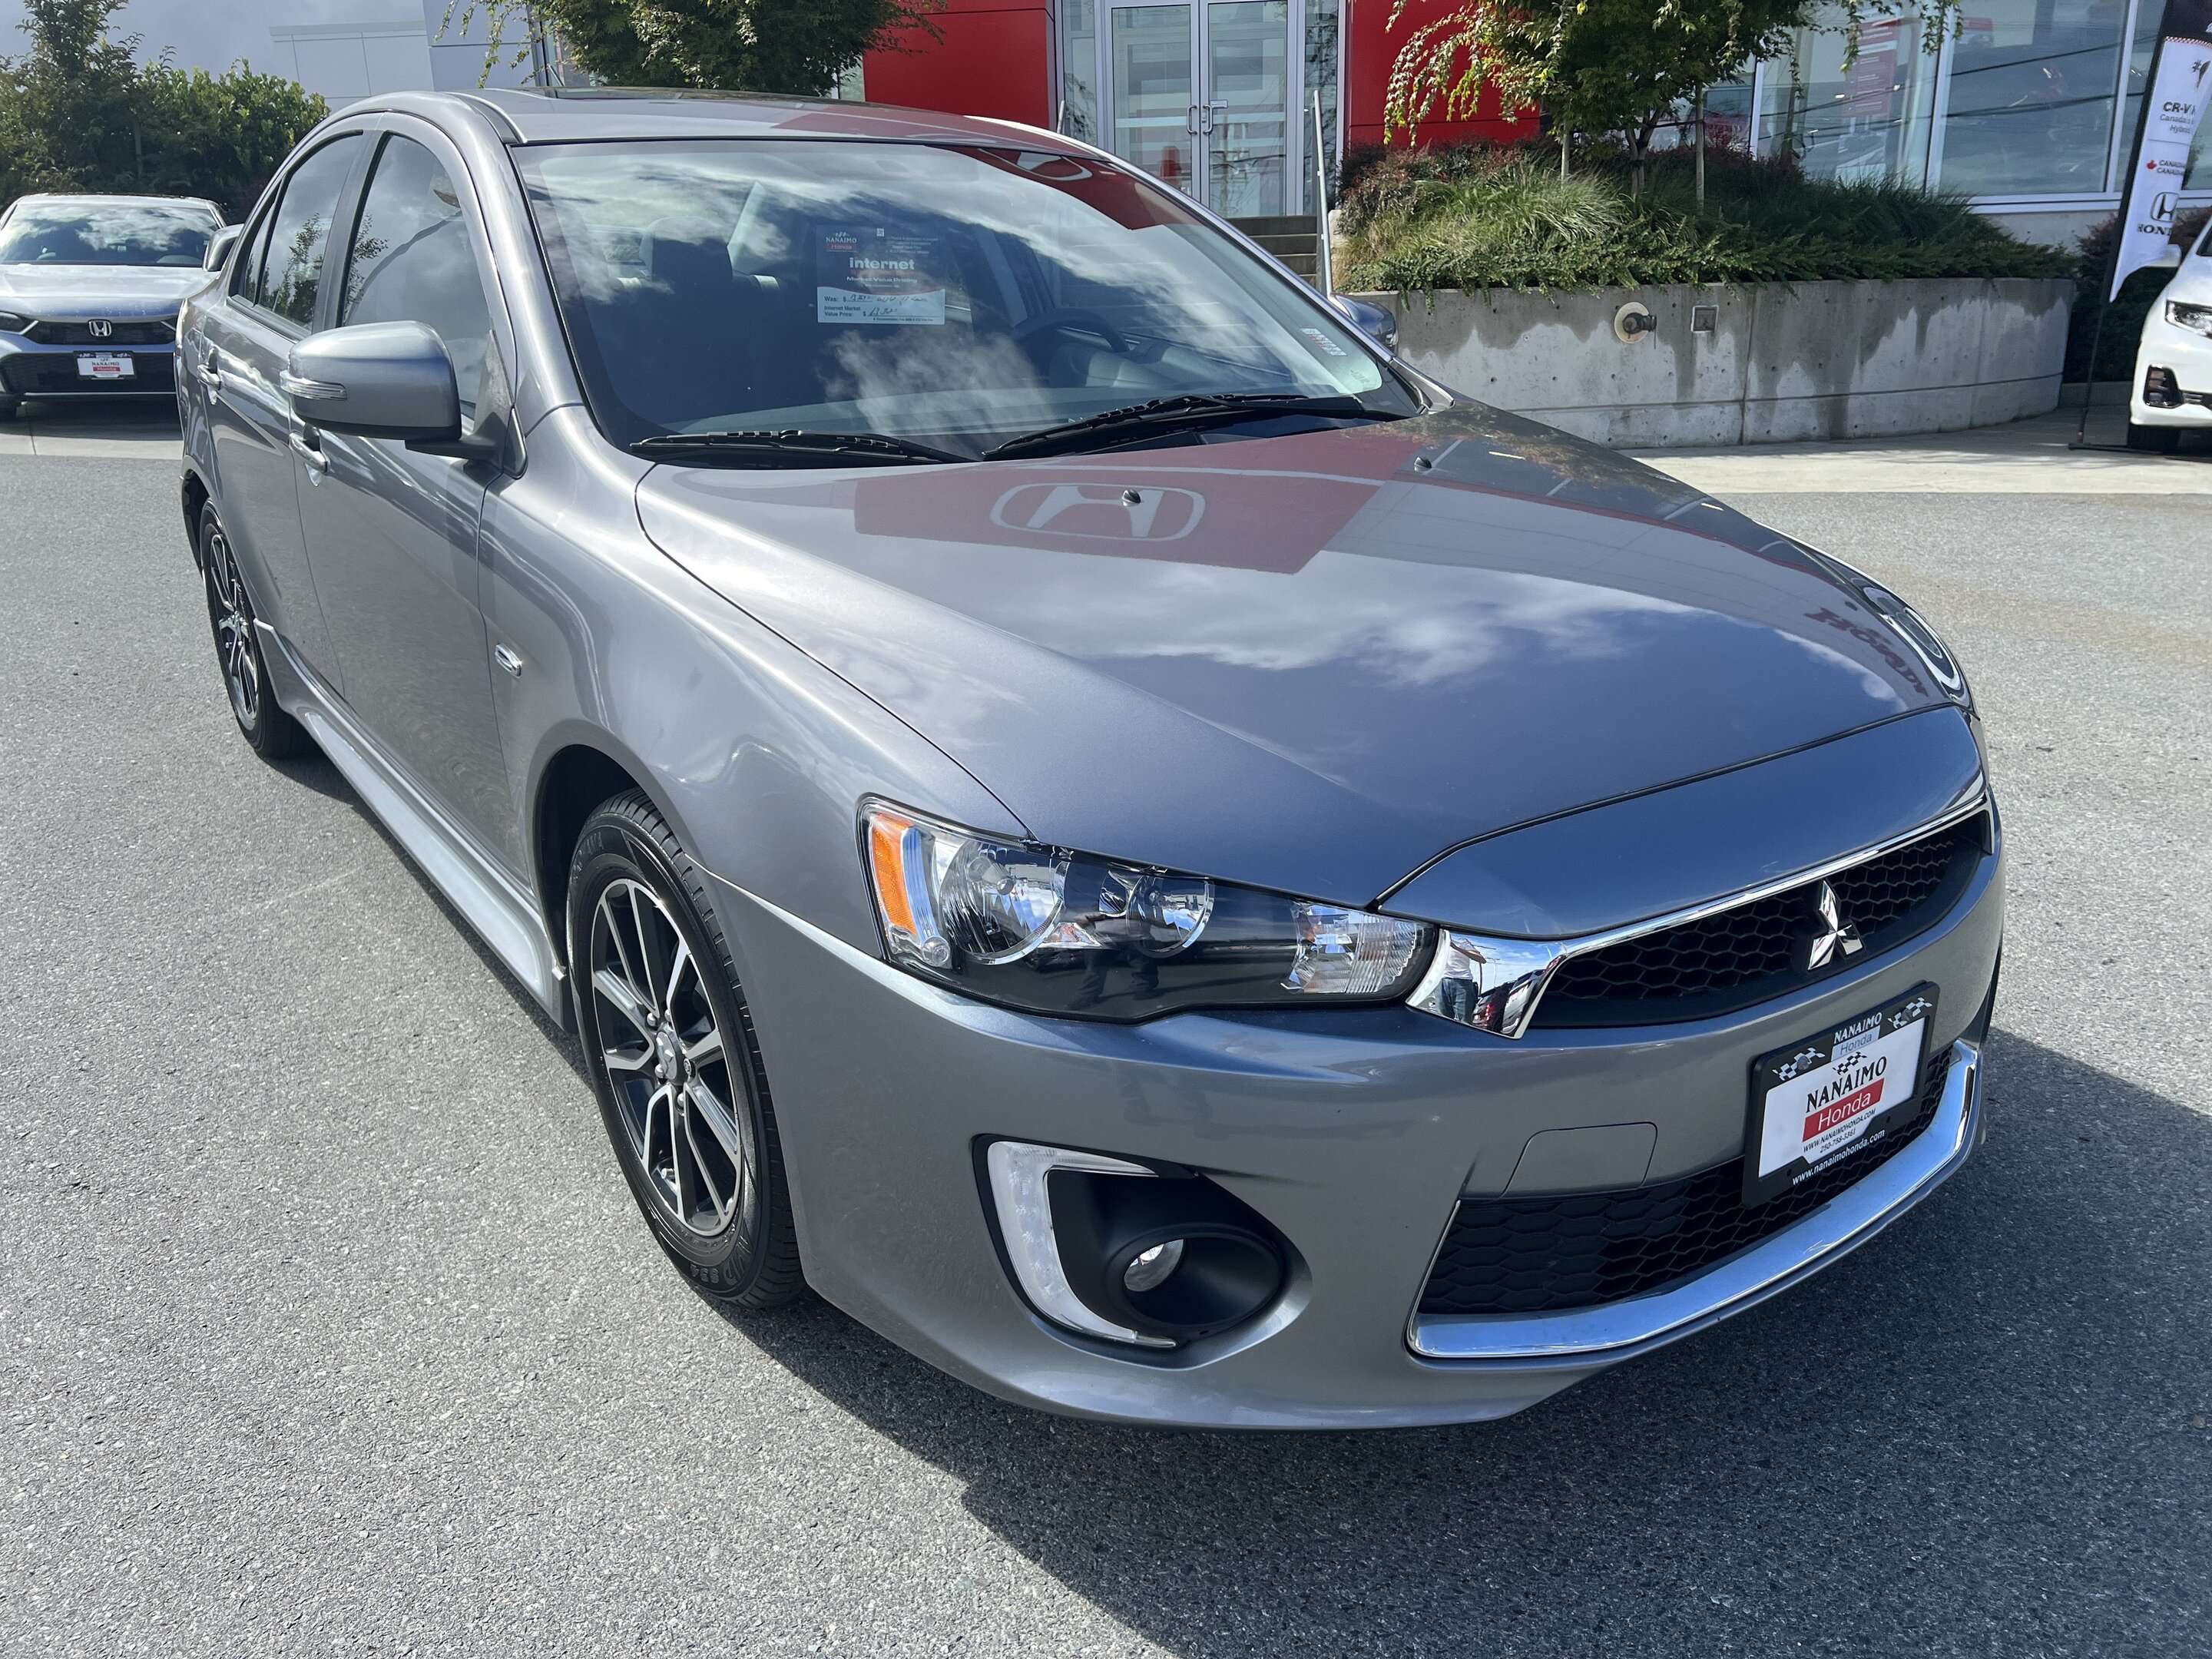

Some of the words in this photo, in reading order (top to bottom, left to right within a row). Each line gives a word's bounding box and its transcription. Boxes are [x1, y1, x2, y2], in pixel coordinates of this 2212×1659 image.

[2163, 101, 2192, 114] CR-V
[1833, 1012, 1883, 1045] NANAIMO
[1840, 1032, 1873, 1055] Honda
[1806, 1056, 1887, 1113] NANAIMO
[1818, 1092, 1872, 1131] Honda
[1793, 1129, 1886, 1185] www.nanaimohonda.com
